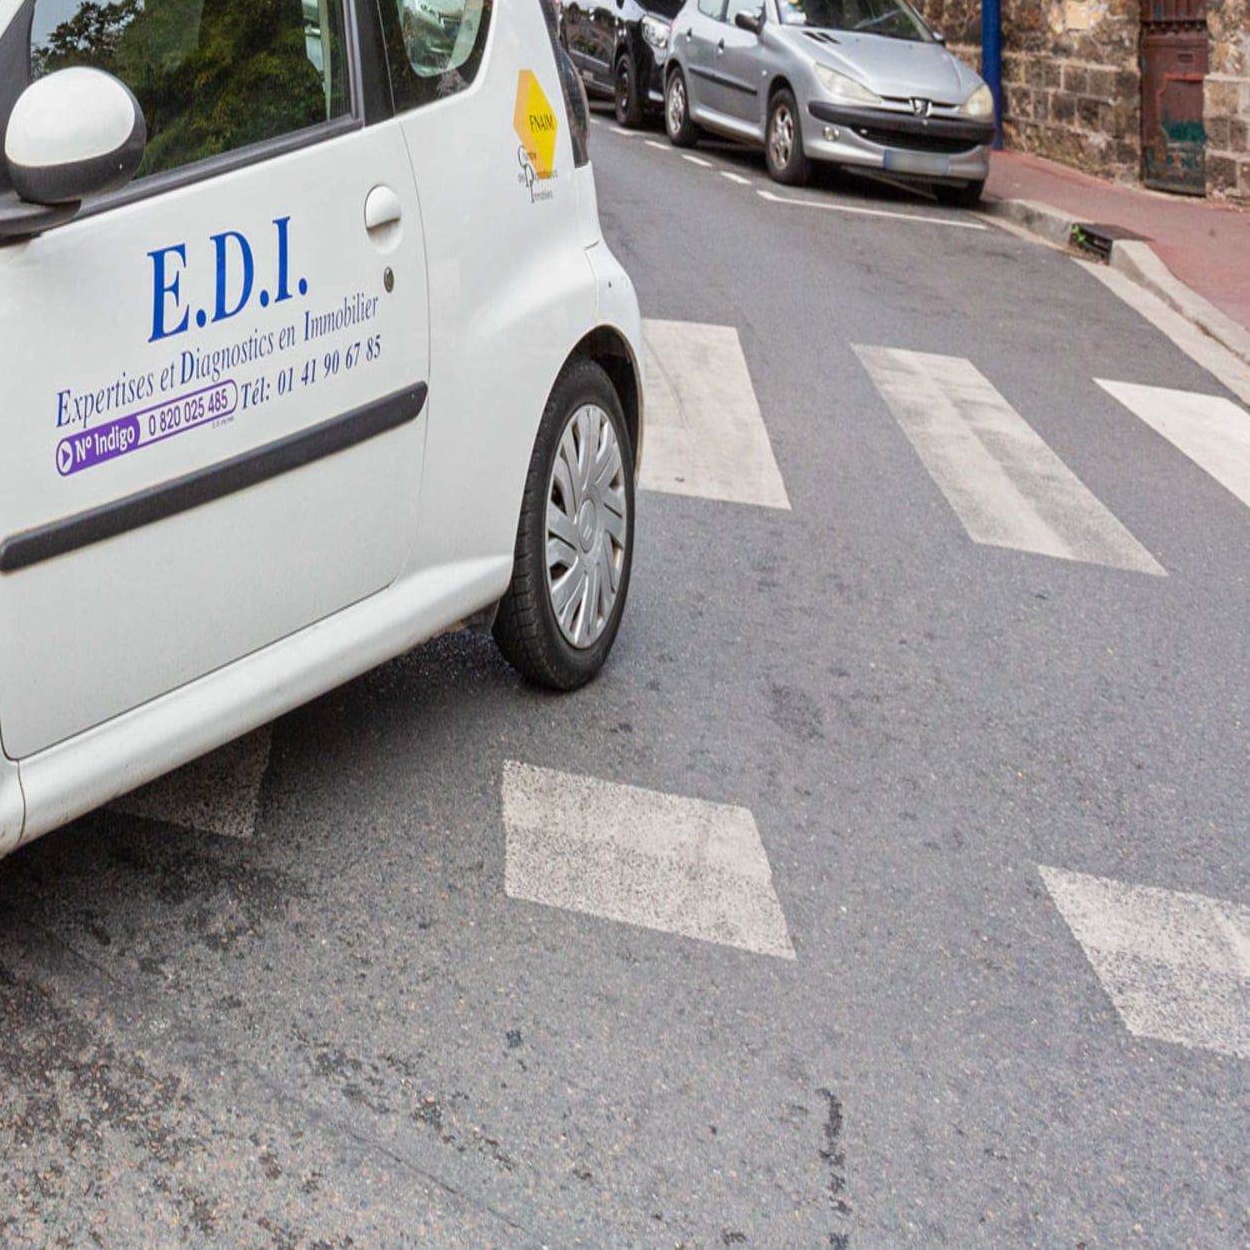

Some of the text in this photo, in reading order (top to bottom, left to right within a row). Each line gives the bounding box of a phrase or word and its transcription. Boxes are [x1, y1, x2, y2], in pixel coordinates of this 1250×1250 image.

[530, 114, 554, 132] FNAIM
[147, 216, 308, 343] E.D.I.
[56, 295, 379, 429] Expertises et Diagnostics en Immobilier
[277, 367, 294, 396] 01
[301, 358, 317, 386] 41
[324, 352, 340, 379] 90
[345, 342, 361, 370] 67
[366, 334, 382, 361] 85
[149, 415, 156, 436] 0
[160, 405, 181, 433] 820
[184, 397, 205, 423] 025
[208, 388, 228, 414] 485
[94, 425, 135, 456] Indigo
